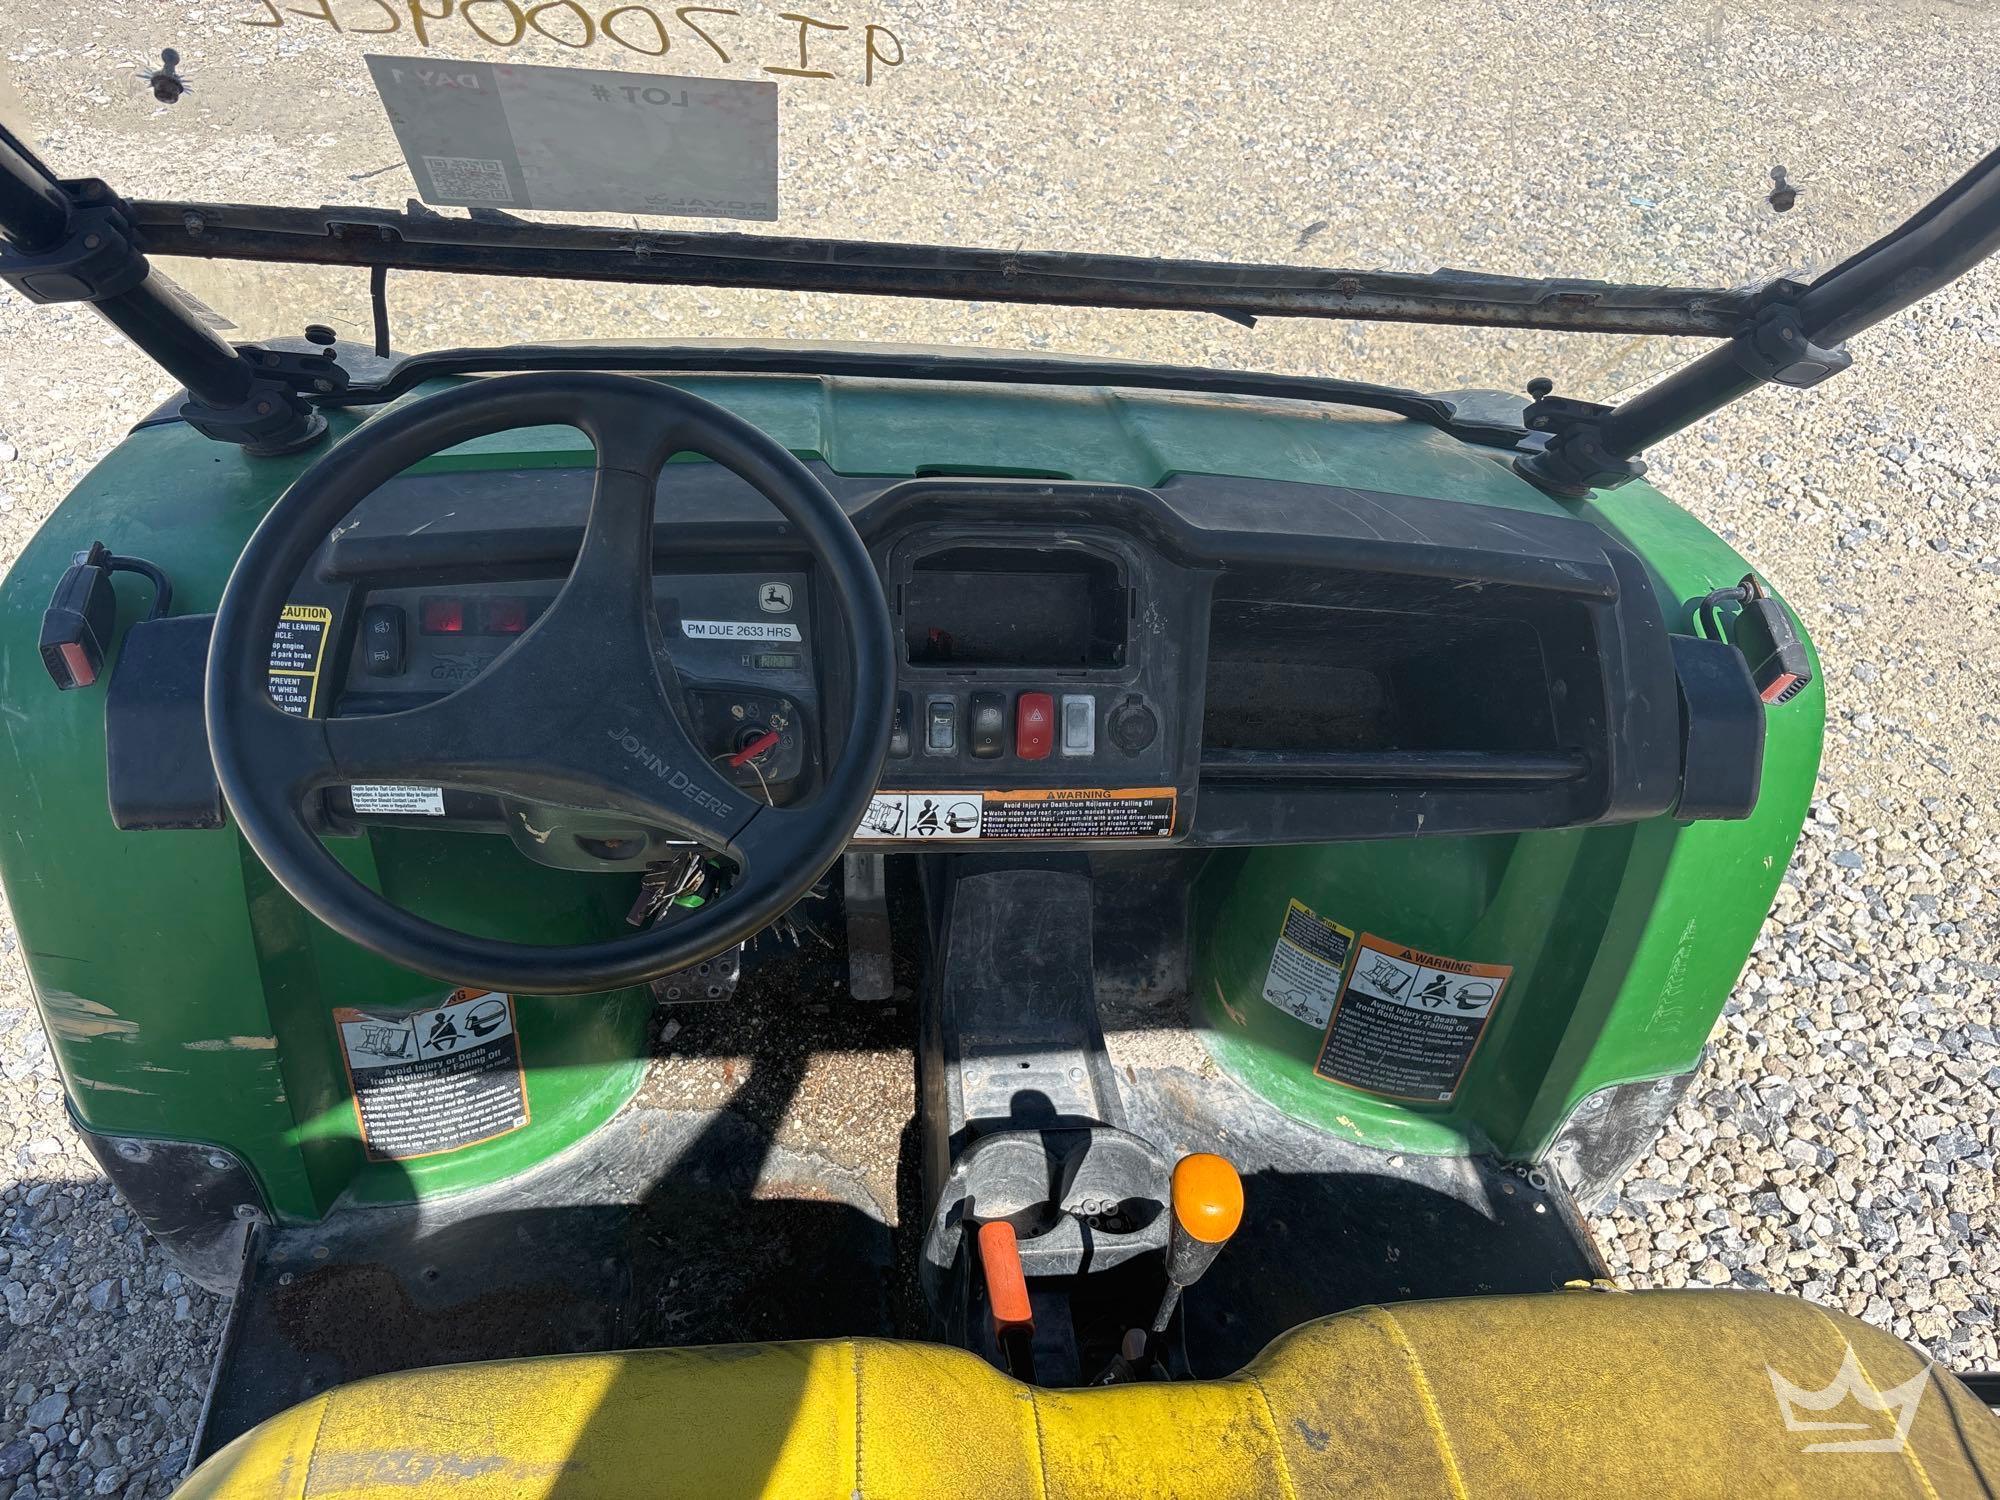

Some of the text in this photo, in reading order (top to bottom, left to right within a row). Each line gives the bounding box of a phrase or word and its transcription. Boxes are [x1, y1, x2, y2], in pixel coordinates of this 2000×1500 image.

[292, 623, 320, 631] LEAVING
[687, 624, 792, 637] PM DUE 2633 HRS
[282, 643, 304, 651] engine
[294, 660, 305, 669] key
[431, 666, 482, 680] GATO
[270, 677, 301, 685] PREVENT
[277, 686, 298, 694] WHEN
[285, 694, 307, 703] LOADS
[284, 705, 302, 713] brake
[607, 727, 733, 818] JOHN DEERE
[1056, 790, 1111, 798] WARNING
[1022, 801, 1040, 809] Injury
[1413, 953, 1473, 972] WARNING
[1370, 999, 1396, 1012] Avoid
[1394, 1007, 1421, 1019] Injury
[1432, 1016, 1458, 1024] Death
[1354, 1002, 1376, 1013] from
[1375, 1009, 1414, 1023] Rollover
[1424, 1021, 1454, 1030] Falling
[1455, 1024, 1470, 1032] Off
[384, 1047, 486, 1076] Avoid Injury or Death
[370, 1076, 394, 1086] from
[396, 1068, 437, 1082] Rollover
[452, 1056, 486, 1071] Falling
[487, 1048, 501, 1059] Off
